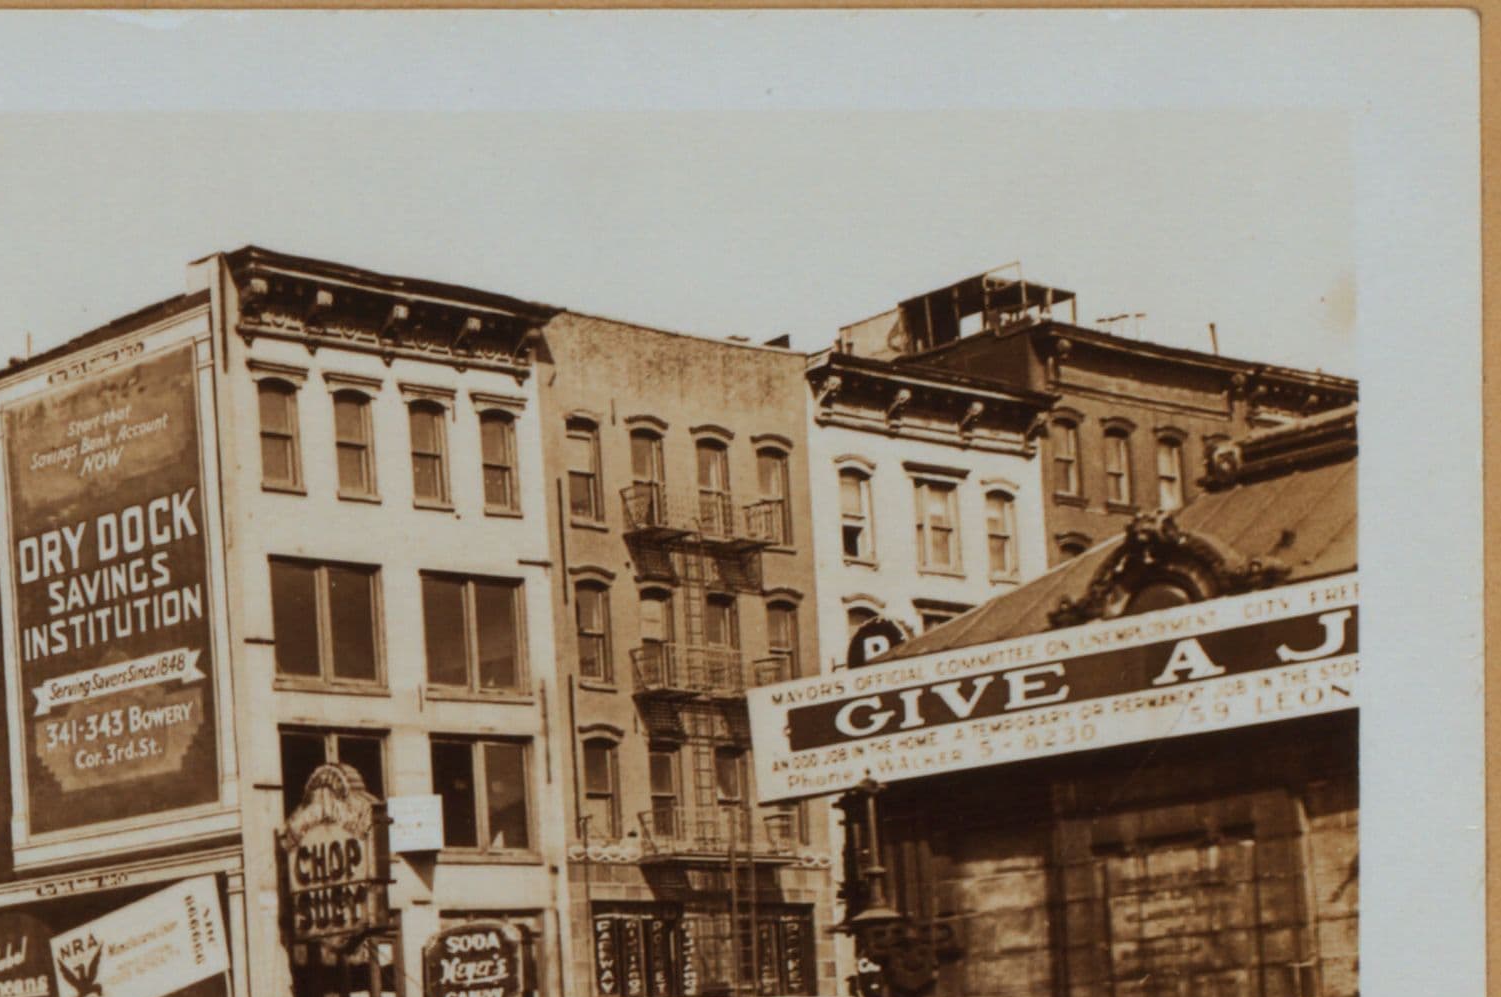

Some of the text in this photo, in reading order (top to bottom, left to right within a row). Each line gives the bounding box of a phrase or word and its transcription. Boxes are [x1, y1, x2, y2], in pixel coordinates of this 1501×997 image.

[30, 444, 78, 471] Savings
[116, 412, 169, 444] Account
[79, 447, 125, 478] NOW
[19, 487, 198, 584] DRY DOCK
[48, 551, 171, 616] SAVINGS
[24, 583, 202, 662] INSTITUTION
[856, 669, 925, 692] OFFICIAL
[935, 645, 1035, 676] COMMITTEE
[1043, 638, 1071, 656] ON
[1244, 597, 1291, 619] CITY
[50, 679, 90, 700] Serving
[91, 671, 127, 691] Savers
[127, 663, 156, 683] Since
[835, 609, 1352, 737] GIVE A J
[128, 701, 194, 734] BOWERY
[772, 759, 789, 773] AN
[824, 746, 848, 766] JOB
[870, 738, 892, 754] THE
[897, 731, 938, 750] HOME
[971, 710, 1070, 736] TEMPORARY
[1079, 702, 1104, 720] OR
[1112, 686, 1205, 713] PERMANENT
[1281, 670, 1308, 685] THE
[295, 836, 362, 886] CHOP
[298, 883, 369, 930] SUEY
[59, 933, 98, 960] NRA
[445, 931, 500, 953] SODA
